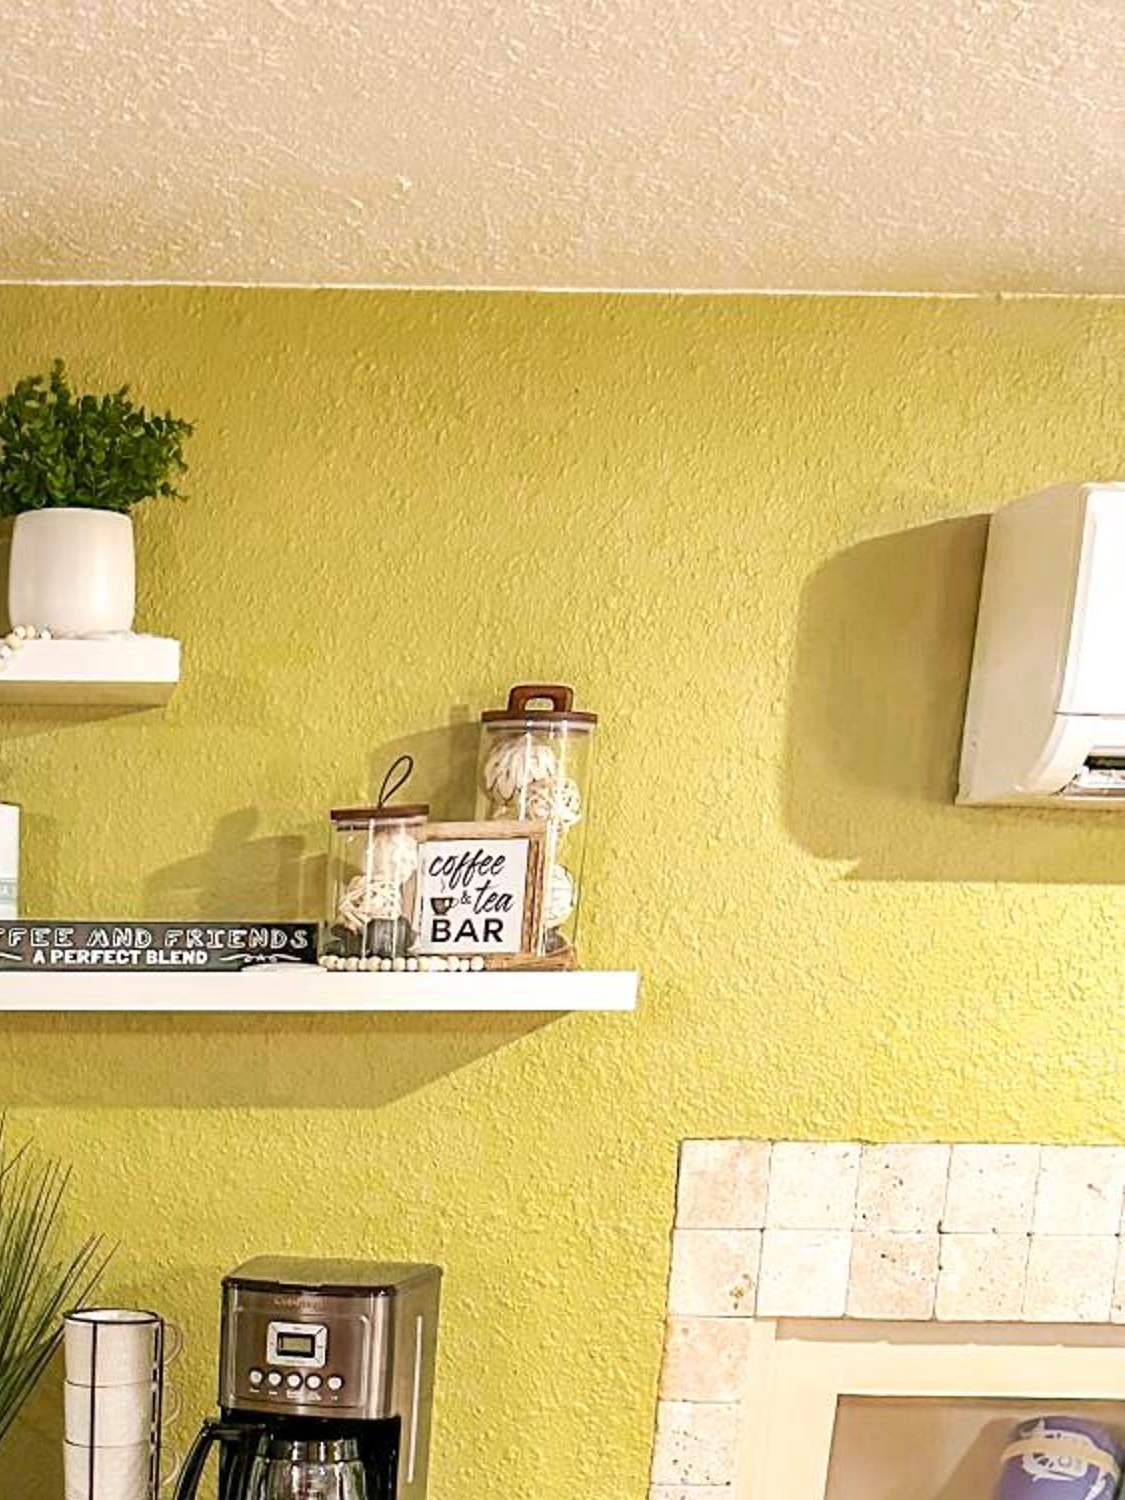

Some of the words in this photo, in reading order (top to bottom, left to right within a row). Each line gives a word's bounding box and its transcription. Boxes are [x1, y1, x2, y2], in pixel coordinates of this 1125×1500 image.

[428, 848, 507, 888] coffee
[460, 891, 472, 905] &
[473, 880, 515, 915] tea
[86, 927, 153, 949] AND
[163, 928, 310, 950] FRIENDS
[430, 917, 504, 943] BAR
[32, 950, 46, 964] A
[50, 950, 143, 965] PERFECT
[146, 950, 208, 966] BLEND
